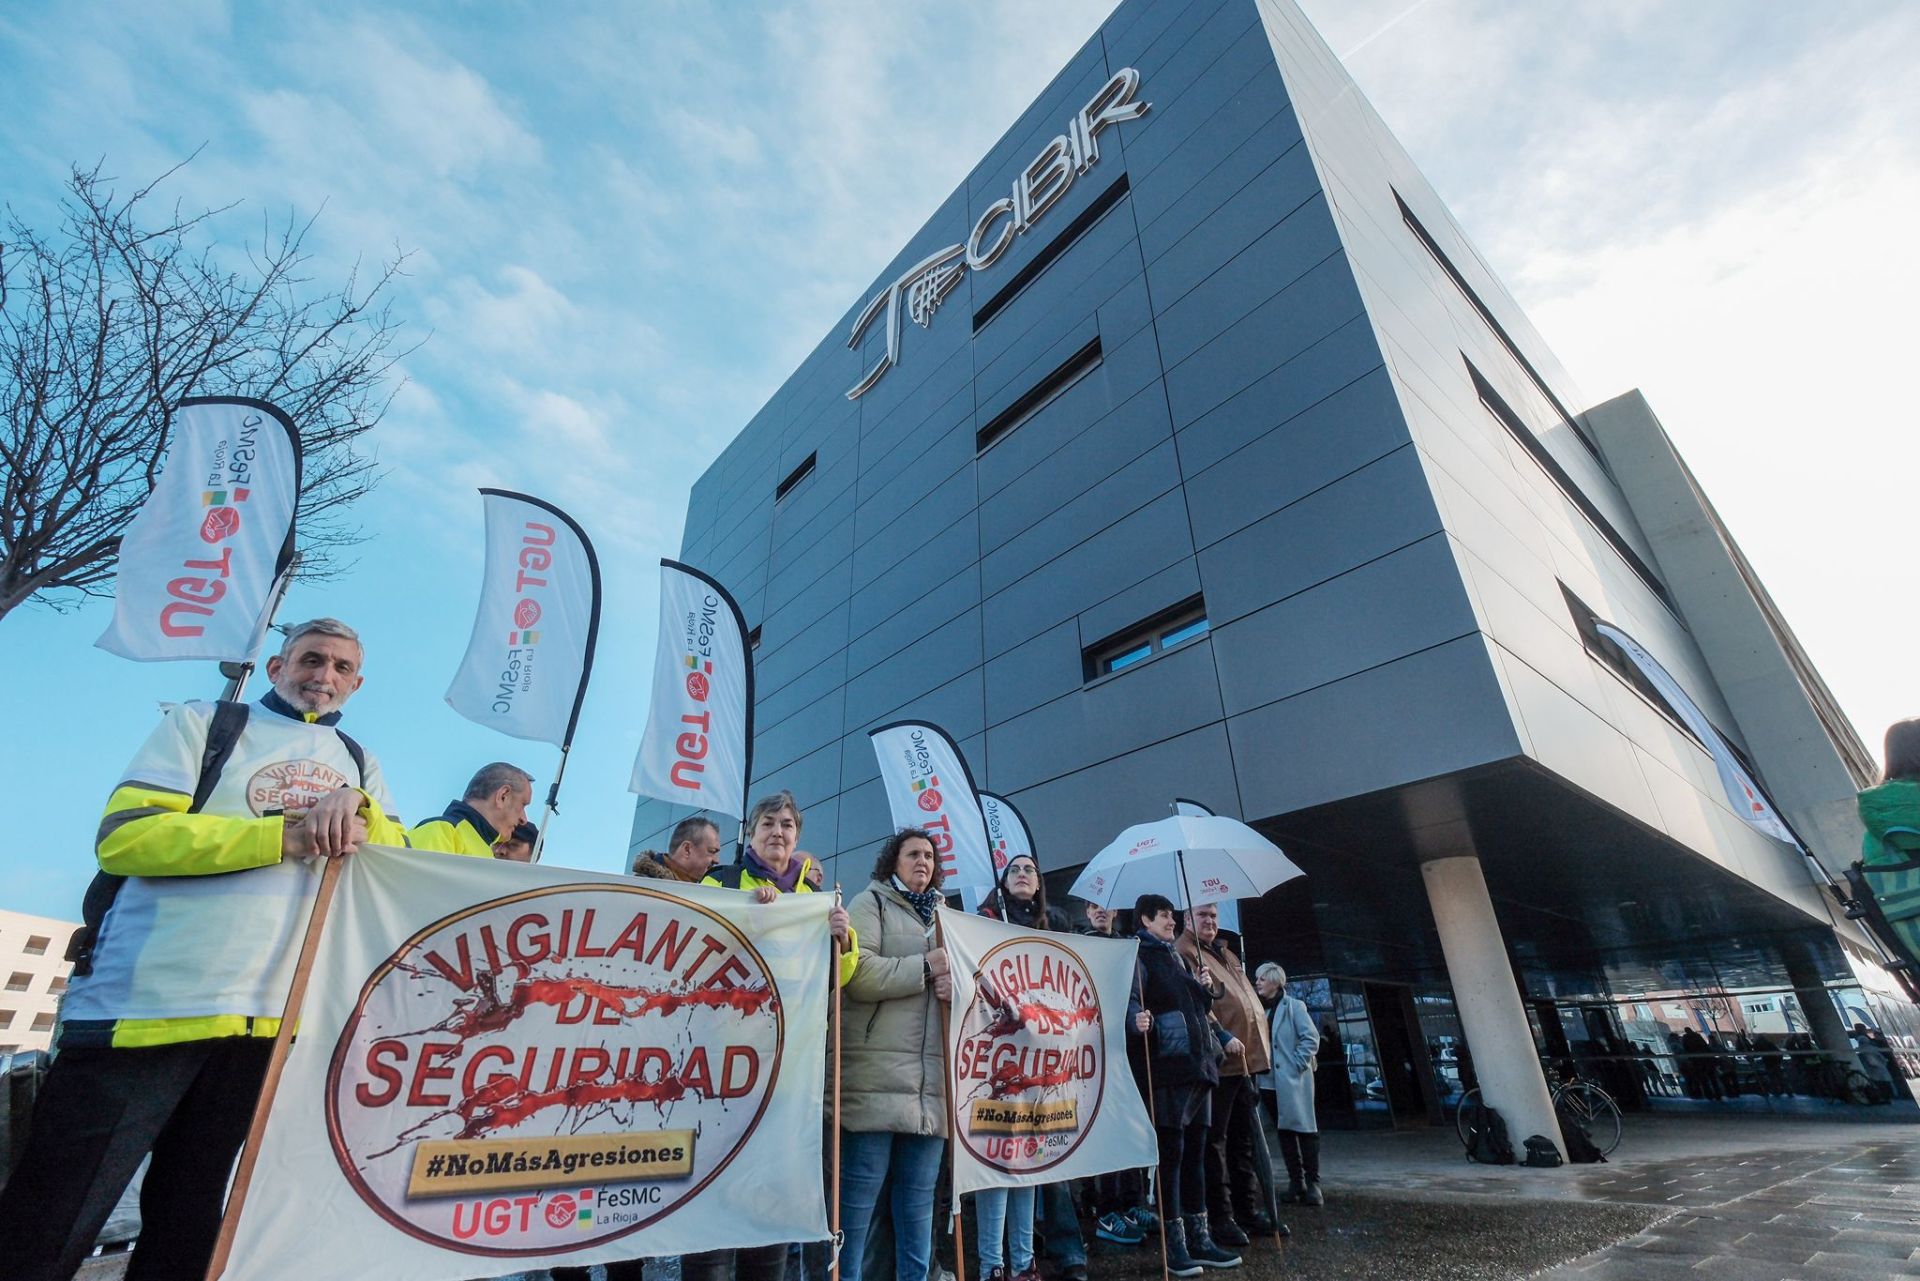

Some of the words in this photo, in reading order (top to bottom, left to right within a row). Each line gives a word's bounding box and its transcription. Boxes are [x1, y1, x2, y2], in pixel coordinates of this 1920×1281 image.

[966, 67, 1153, 270] CIBIR
[265, 763, 345, 787] VIGILANT
[422, 908, 751, 1006] VIGILANTE
[355, 1040, 761, 1110] SEGURIDAD
[986, 1136, 1023, 1161] UGT
[1044, 1135, 1069, 1147] FeSMC
[426, 1145, 684, 1178] #NoMásAgresiones
[597, 1186, 662, 1208] FeSMC
[452, 1196, 540, 1240] UGT
[597, 1213, 610, 1225] La
[612, 1211, 639, 1225] Rioja
